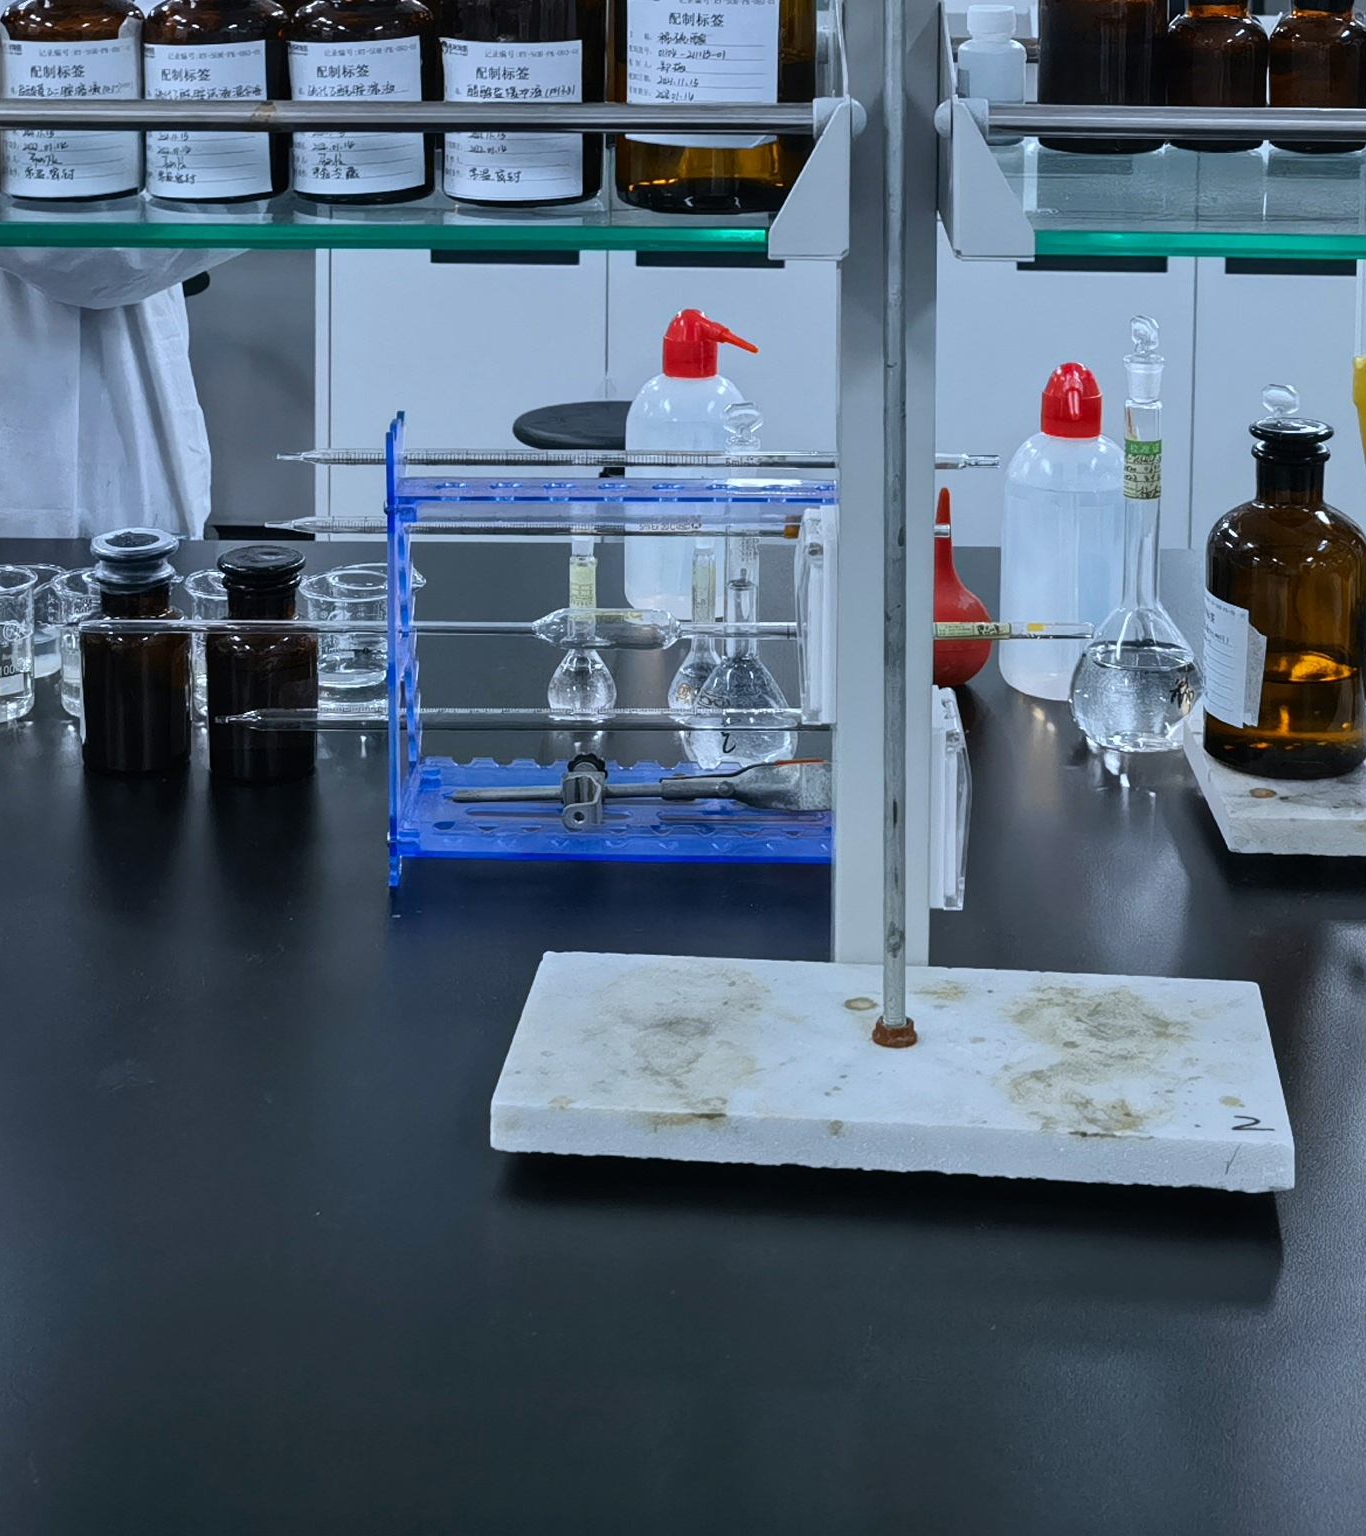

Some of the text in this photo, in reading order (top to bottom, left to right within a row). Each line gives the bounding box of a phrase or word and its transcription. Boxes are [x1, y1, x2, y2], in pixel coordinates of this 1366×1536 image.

[668, 12, 725, 27] 配制标签
[30, 64, 85, 79] 配制标签
[161, 68, 211, 82] 配制标签
[317, 64, 369, 79] 配制标签
[476, 66, 530, 81] 配制标签
[1231, 1115, 1275, 1131] 2
